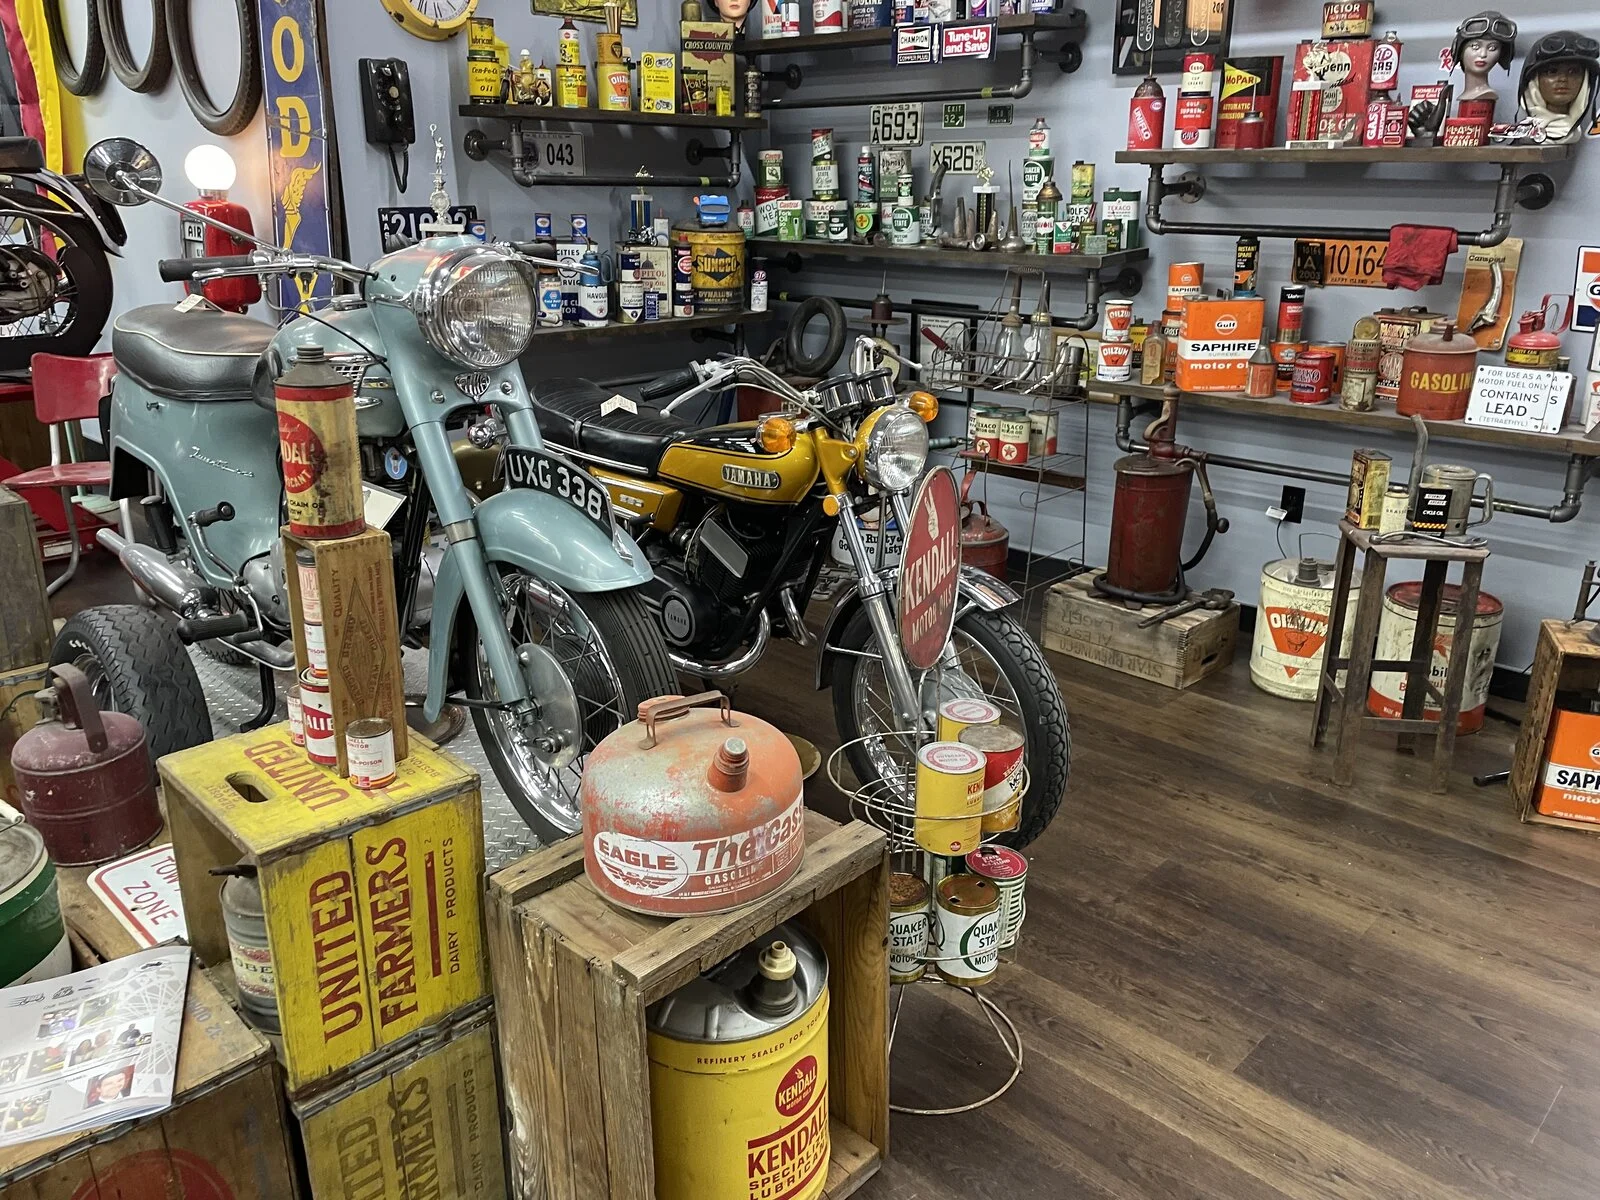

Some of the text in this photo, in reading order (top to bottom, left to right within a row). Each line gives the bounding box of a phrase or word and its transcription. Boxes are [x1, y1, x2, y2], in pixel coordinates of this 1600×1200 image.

[764, 15, 782, 25] VALVO
[1324, 3, 1361, 25] VICTOR
[900, 35, 928, 44] CHAMPION
[947, 30, 987, 43] Tune-Up
[684, 40, 733, 51] CROSS COUNTRY
[945, 41, 988, 54] and Save
[947, 105, 962, 113] EXIT
[1223, 102, 1251, 110] AUTOMATIC
[881, 111, 919, 141] 693
[943, 114, 956, 123] 32
[1133, 106, 1152, 140] UNIFLO
[1366, 113, 1379, 140] GAS
[1182, 131, 1199, 141] GULF
[1443, 138, 1480, 147] CLEANER
[546, 143, 575, 166] 043
[1024, 174, 1039, 182] STATE
[779, 201, 799, 209] Castrol
[187, 225, 202, 238] AIR
[894, 219, 908, 227] STATE
[696, 259, 738, 273] SUNOCO
[1163, 327, 1179, 336] CROSS
[1216, 321, 1237, 329] Gulf
[1102, 346, 1129, 356] OILZUM
[1190, 342, 1257, 353] SAPHIRE
[1189, 361, 1232, 371] motor
[1487, 369, 1503, 377] FOR
[1505, 371, 1520, 379] USE
[1522, 372, 1534, 380] AS
[1409, 370, 1474, 391] GASOLIN
[1477, 377, 1505, 386] MOTOR
[1506, 380, 1527, 389] FUEL
[1528, 382, 1549, 391] ONLY
[1480, 388, 1540, 404] CONTAINS
[1484, 401, 1528, 417] LEAD
[724, 467, 773, 487] YAMAHA
[508, 451, 603, 521] UXG 338
[865, 533, 896, 546] Ruty
[904, 525, 957, 616] KENDALL
[331, 568, 343, 618] QUALITY
[666, 610, 688, 627] YAMAHA
[911, 609, 938, 645] MOTOR
[1061, 609, 1114, 632] LAGER
[1269, 612, 1328, 637] OILZUM
[342, 616, 356, 659] BRAND
[1075, 641, 1124, 668] BREWING
[1126, 655, 1163, 679] STAR
[408, 755, 441, 778] BOSTON
[243, 739, 350, 812] UNITED
[1563, 793, 1600, 805] moto
[598, 836, 679, 872] EAGLE
[692, 836, 752, 873] The
[123, 880, 180, 926] ZONE
[441, 837, 462, 974] DAIRY PRODUCTS
[364, 836, 419, 1030] FARMERS
[890, 918, 927, 935] QUAKER
[973, 921, 998, 938] QUAK
[892, 932, 924, 947] STATE
[979, 932, 999, 949] STAT
[309, 869, 364, 1045] UNITED
[890, 952, 915, 963] MOTOR
[696, 1010, 822, 1065] REFINERY SEALED FOR YOUR
[778, 1065, 818, 1108] KENDALL
[785, 1095, 802, 1111] MOTOR
[462, 1068, 485, 1194] DAIRY PRODUCTS
[747, 1096, 829, 1180] KENDALL
[750, 1142, 829, 1200] LUBRICAN
